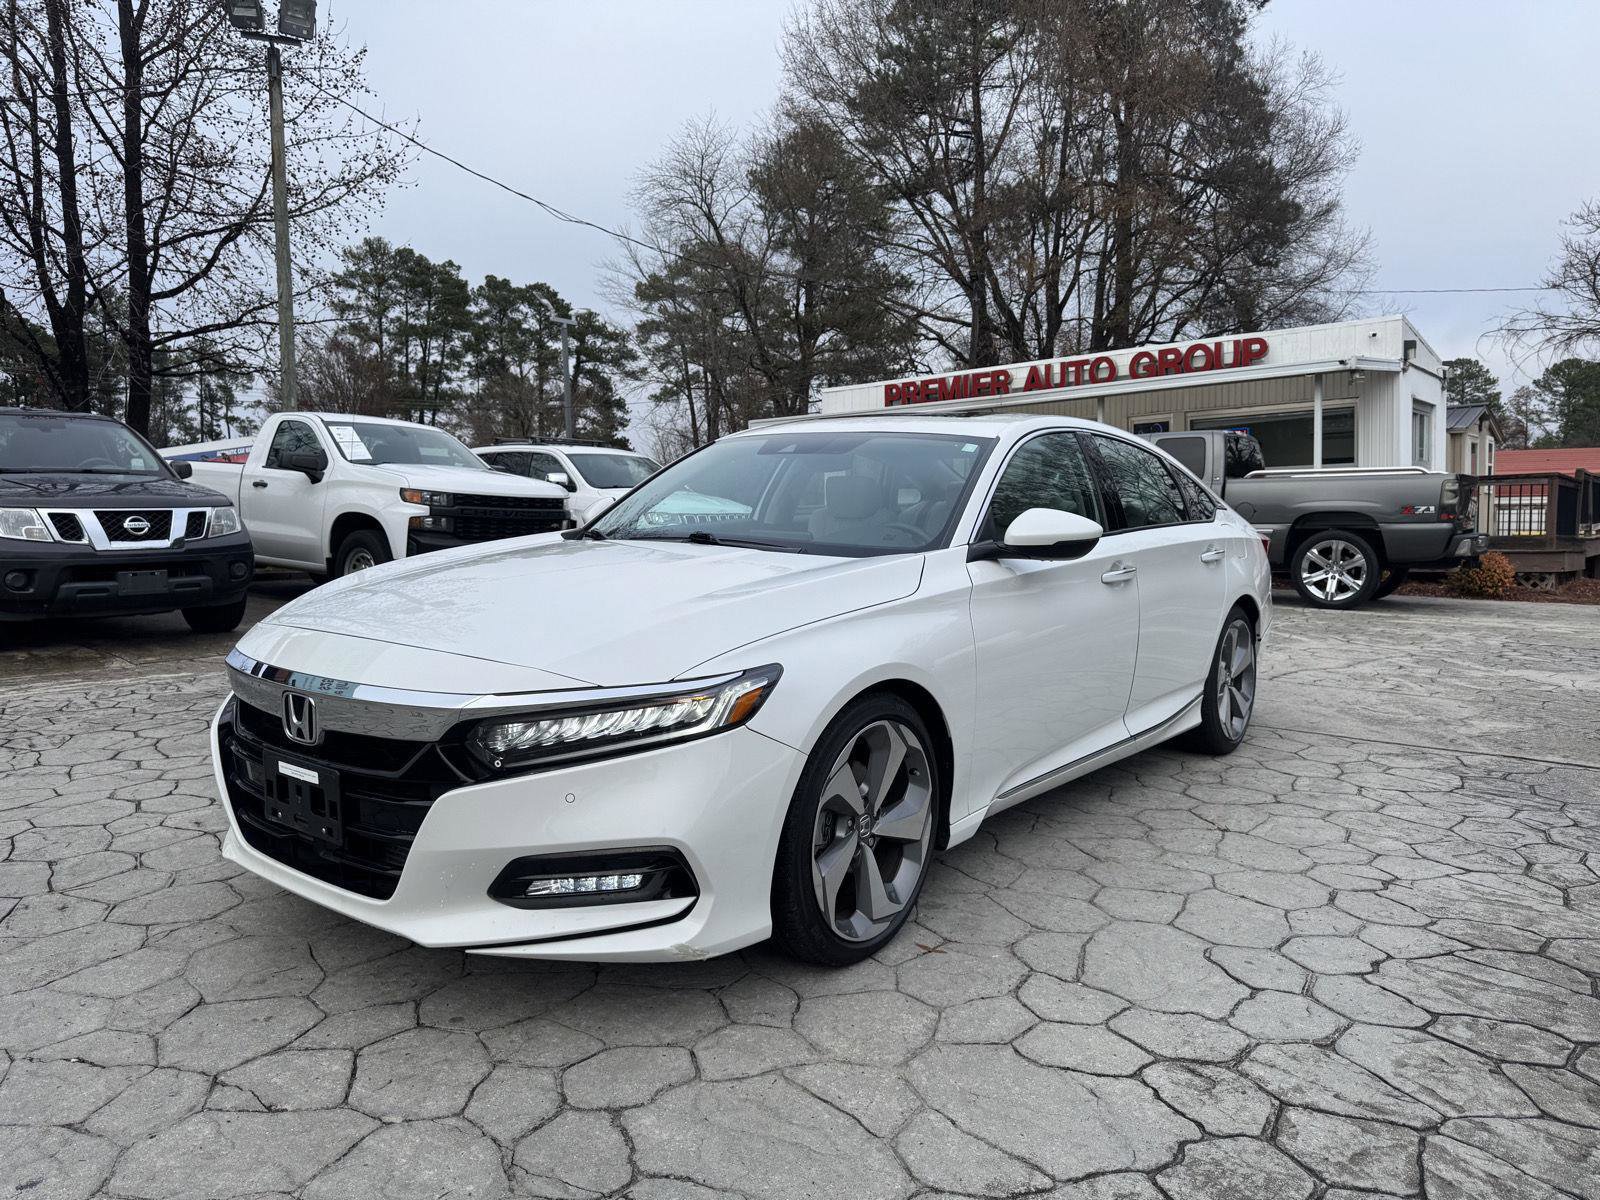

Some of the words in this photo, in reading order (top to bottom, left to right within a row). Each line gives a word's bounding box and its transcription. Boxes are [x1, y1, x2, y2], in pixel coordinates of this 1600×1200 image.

[884, 370, 1012, 407] PREMIER
[1023, 356, 1118, 392] AUTO
[1129, 337, 1269, 379] GROUP
